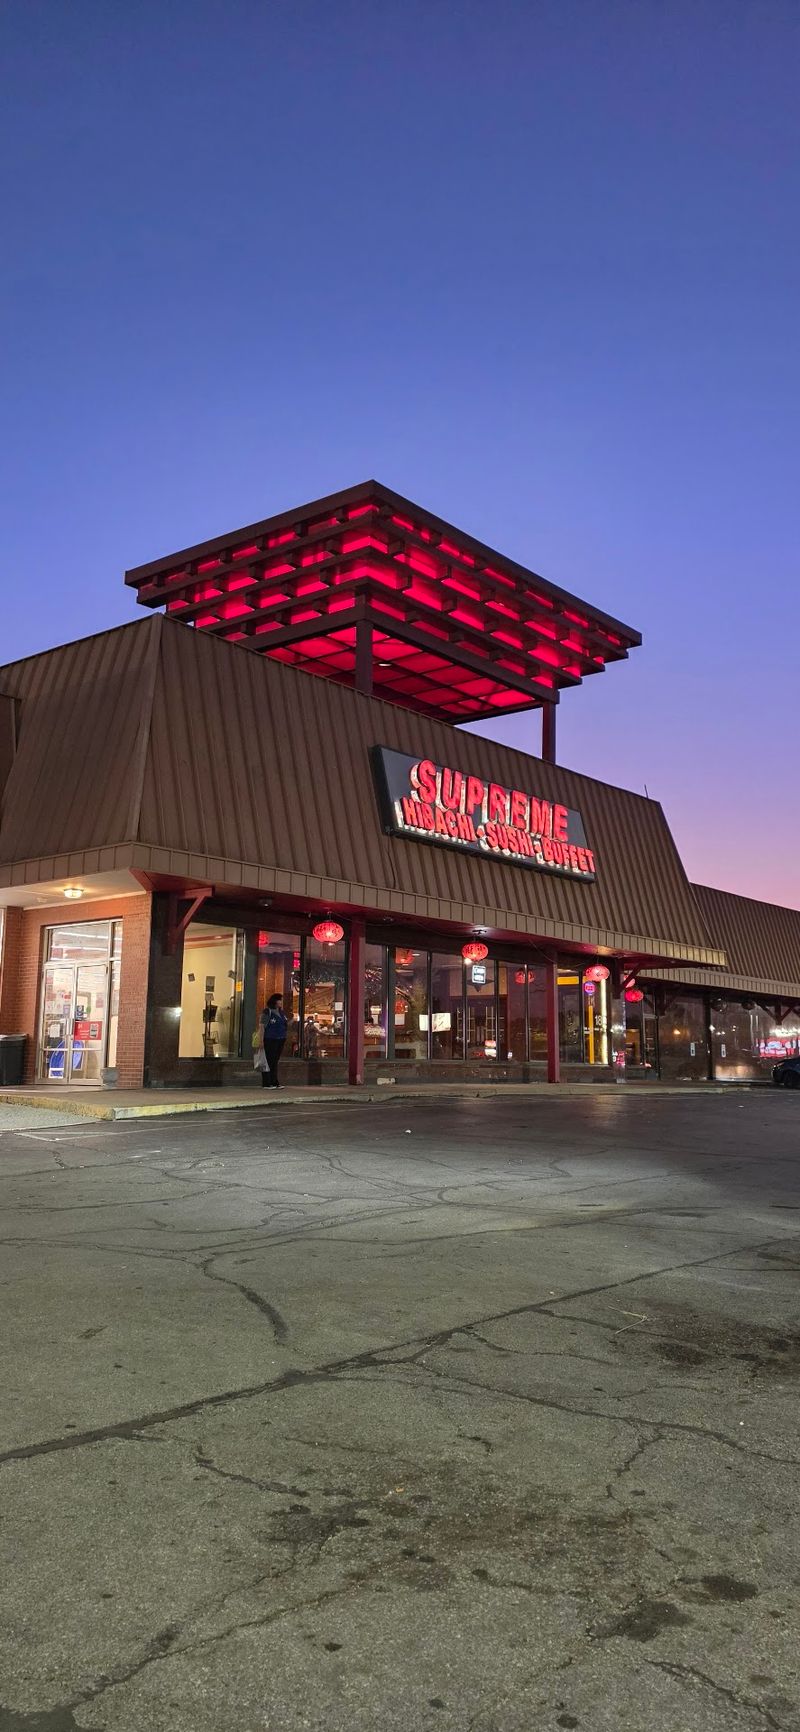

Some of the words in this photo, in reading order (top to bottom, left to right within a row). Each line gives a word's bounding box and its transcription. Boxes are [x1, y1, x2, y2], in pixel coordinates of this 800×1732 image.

[401, 796, 476, 842] HIBACHI
[485, 821, 535, 857] SUSHI
[540, 836, 596, 873] BUFFET
[413, 759, 569, 841] SUPREME
